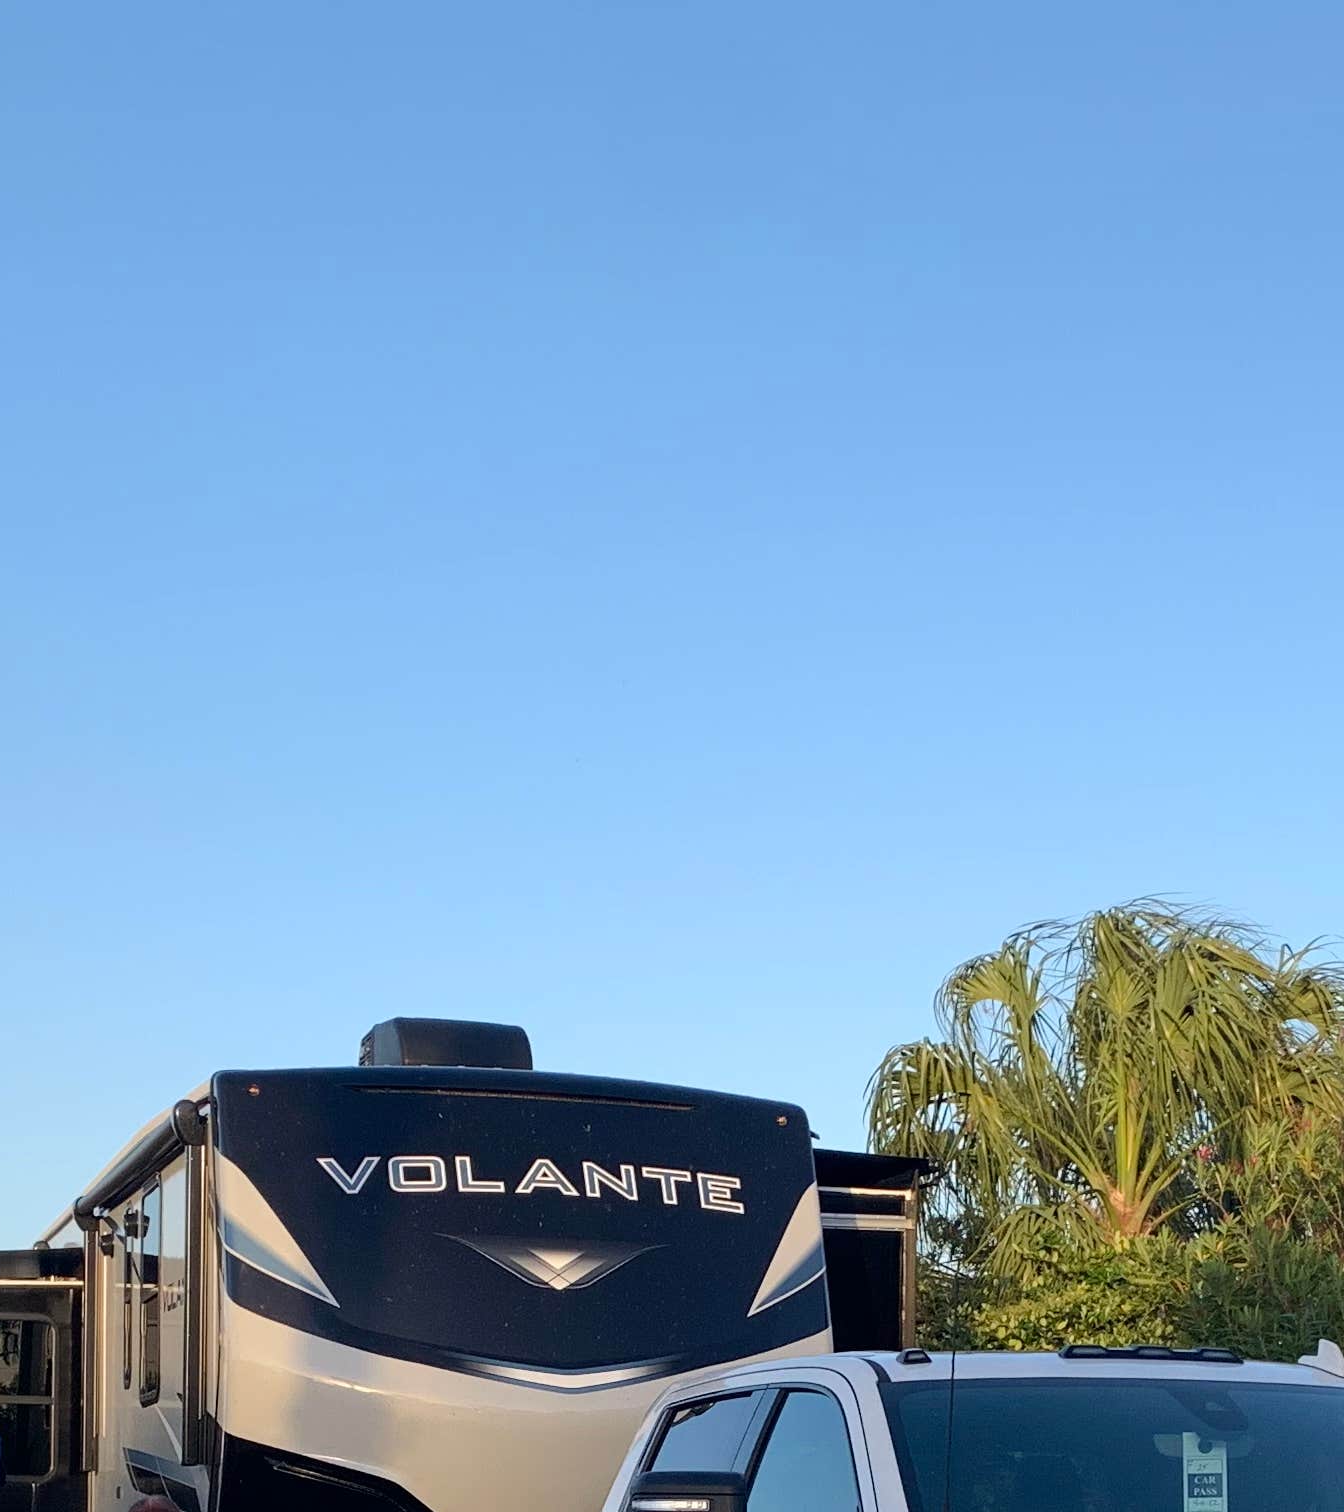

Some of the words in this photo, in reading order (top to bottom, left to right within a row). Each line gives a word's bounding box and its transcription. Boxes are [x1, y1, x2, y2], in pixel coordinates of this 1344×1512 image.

[316, 1155, 745, 1214] VOLANTE
[1194, 1475, 1217, 1485] CAR
[1193, 1487, 1218, 1496] PASS
